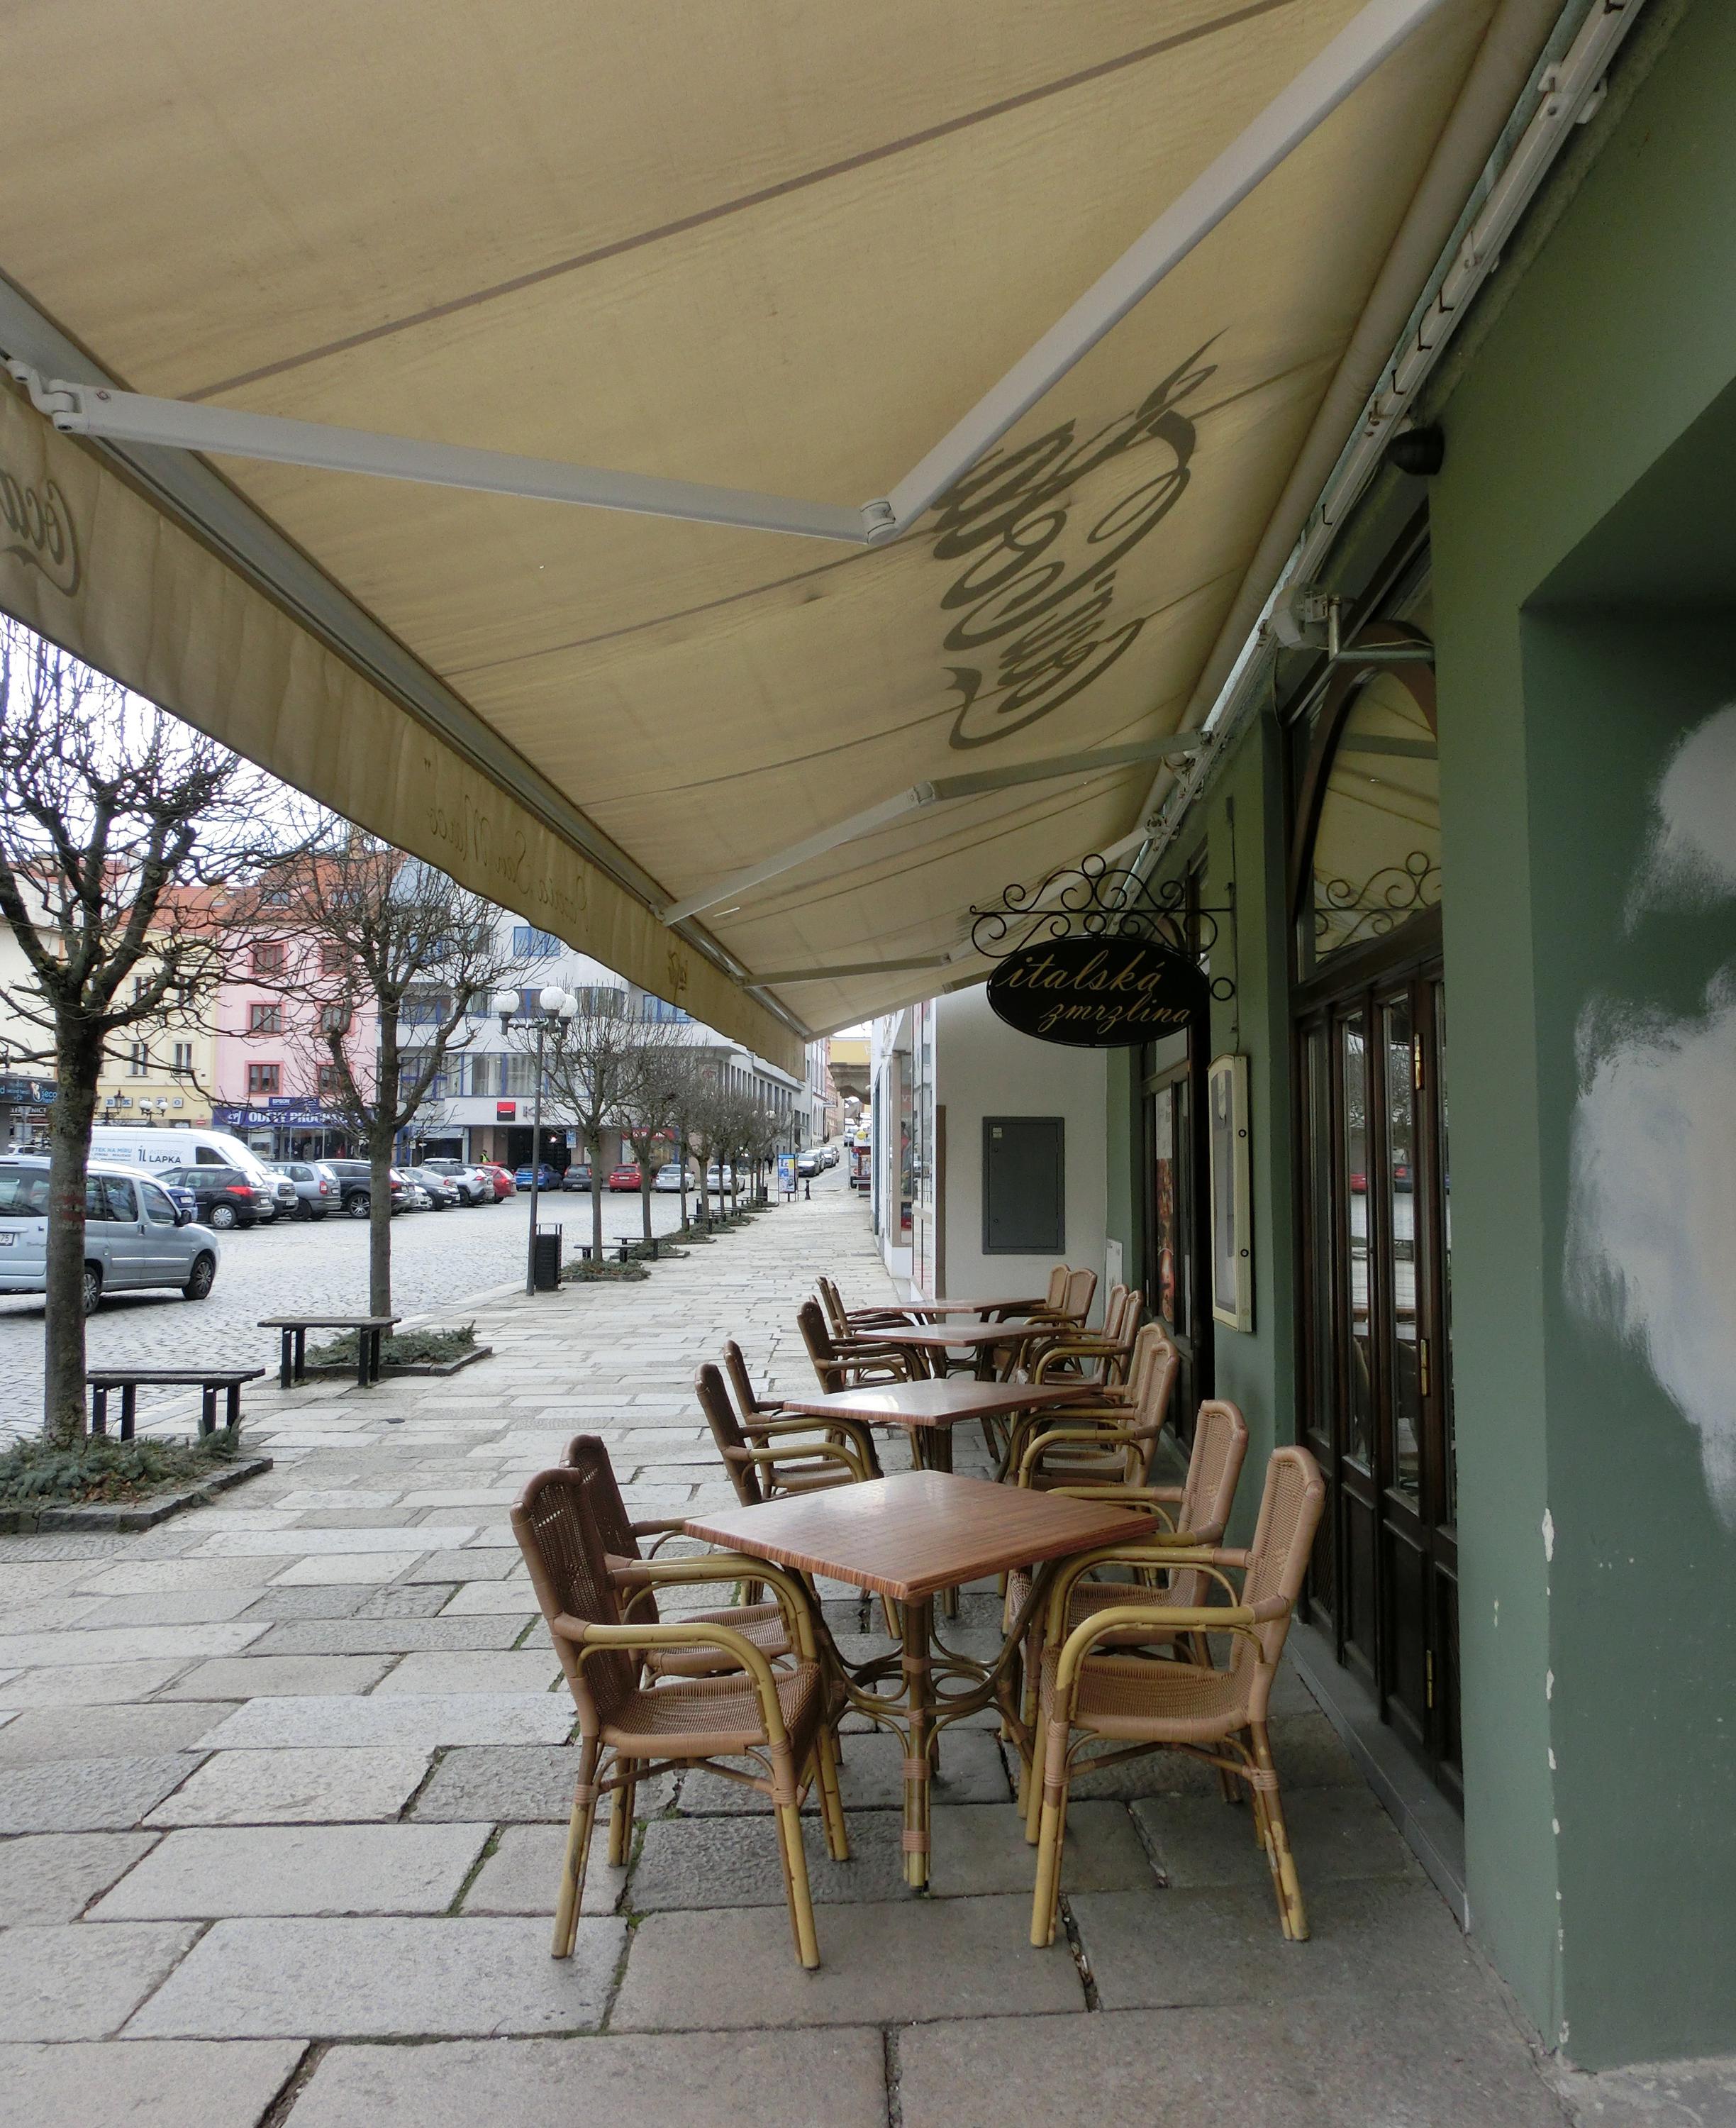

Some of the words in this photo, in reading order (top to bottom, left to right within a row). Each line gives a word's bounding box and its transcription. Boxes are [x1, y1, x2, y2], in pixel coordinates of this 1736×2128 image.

[996, 949, 1165, 992] italská
[1037, 993, 1190, 1034] zmrzlina
[149, 1156, 182, 1164] LAPKA
